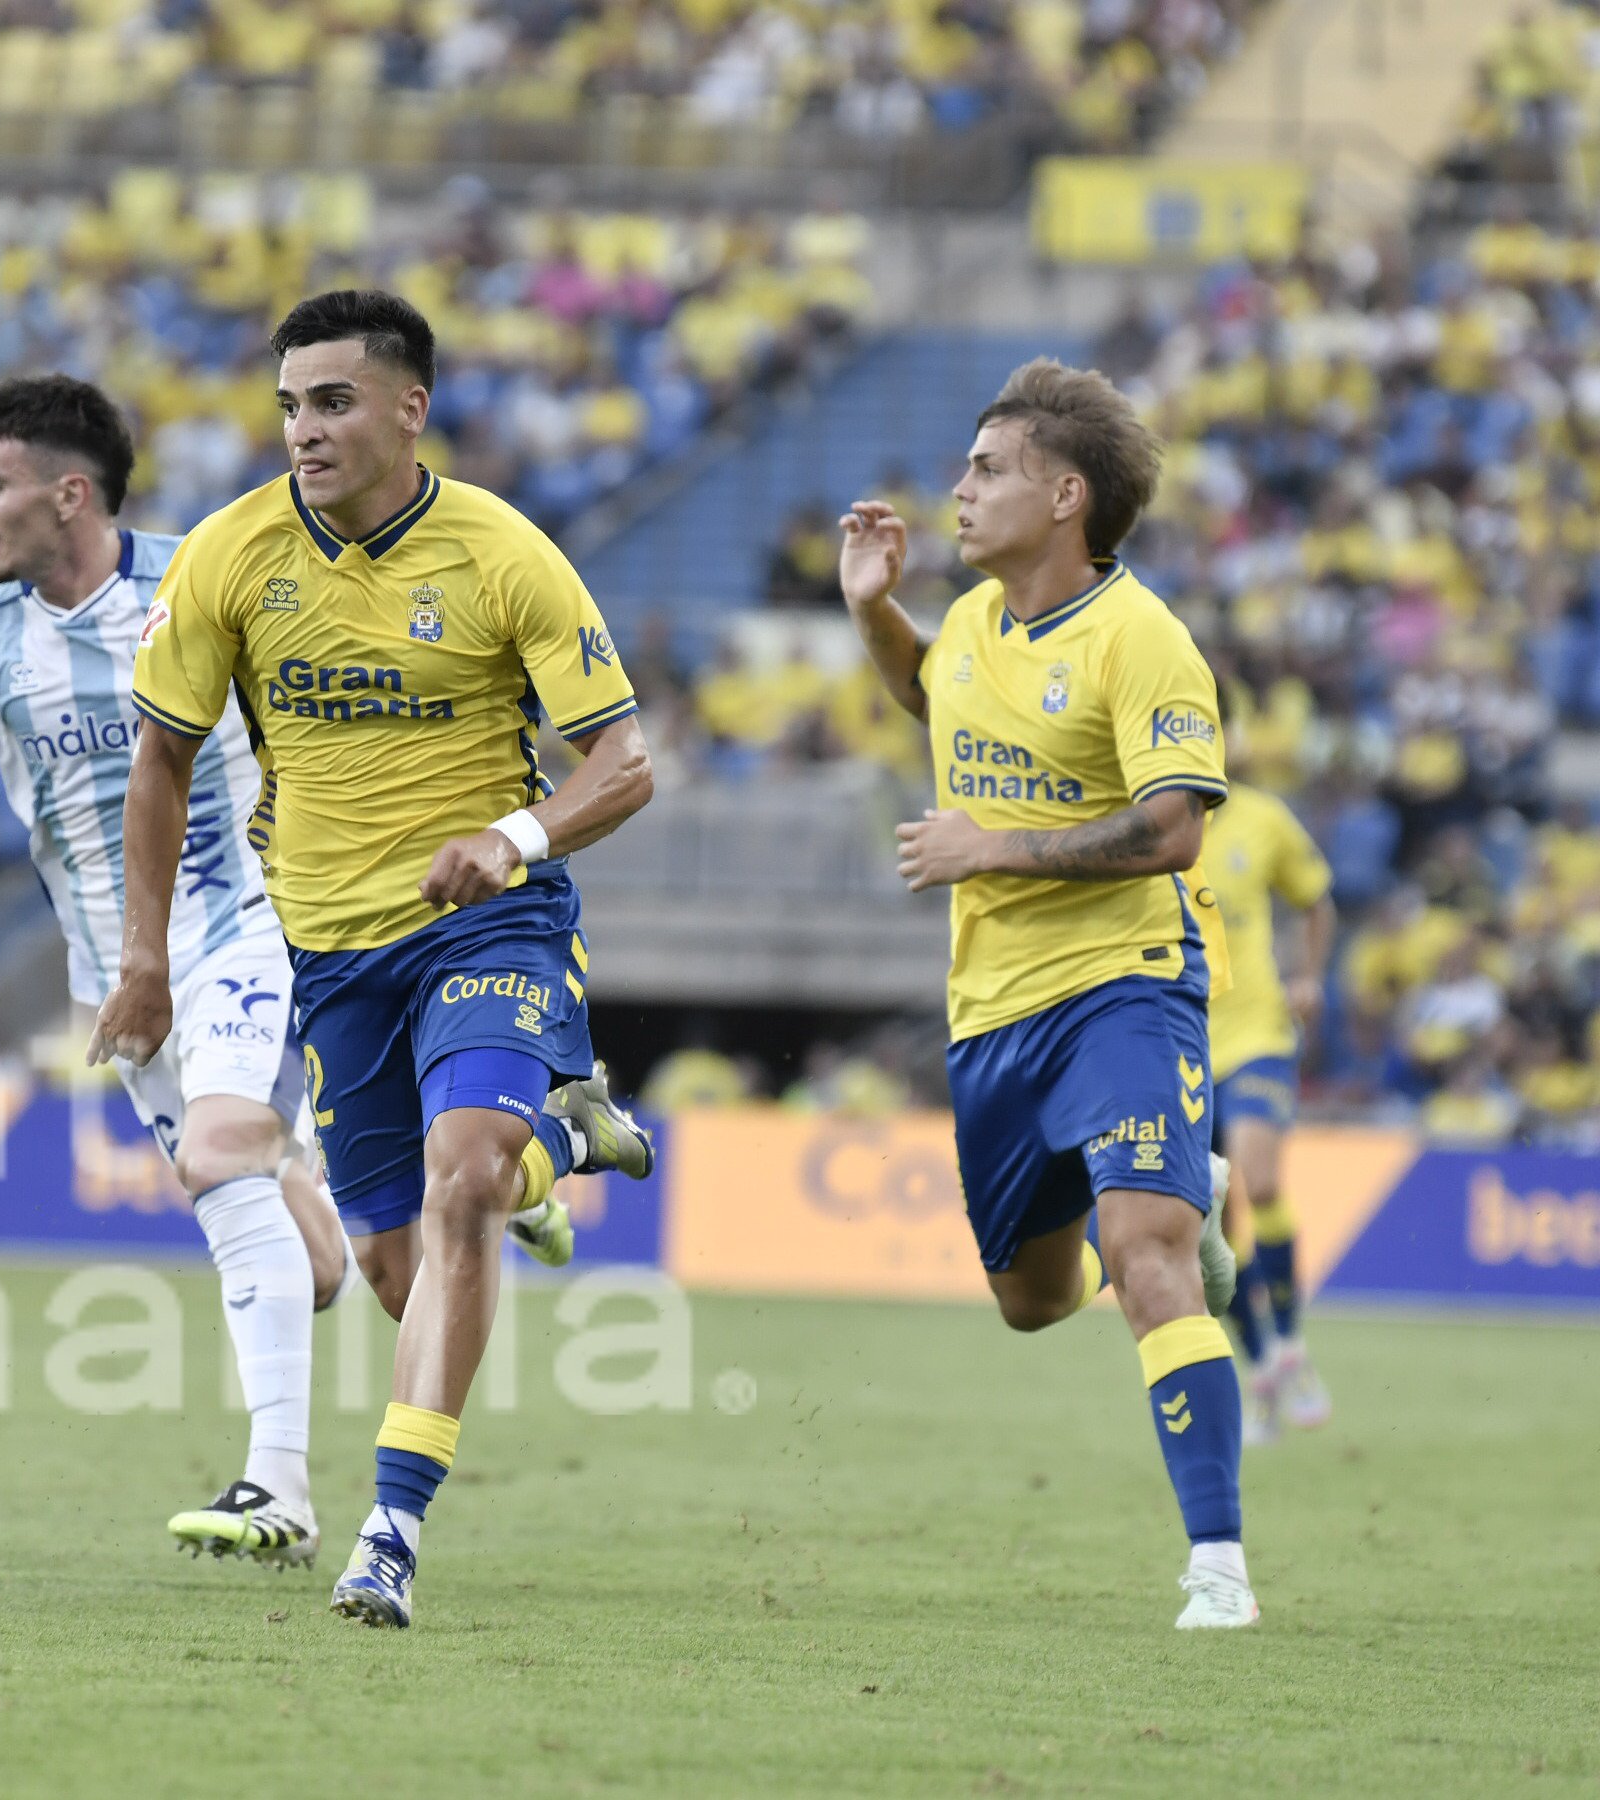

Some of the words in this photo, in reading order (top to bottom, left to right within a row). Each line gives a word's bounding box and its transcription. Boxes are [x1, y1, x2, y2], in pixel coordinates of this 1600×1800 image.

[264, 598, 298, 610] hummel
[279, 658, 402, 692] Gran
[268, 681, 455, 721] Canaria
[1152, 707, 1215, 749] Kalise
[954, 729, 1033, 768] Gran
[949, 763, 1084, 802] Canaria
[441, 972, 550, 1012] Cordial
[208, 1021, 275, 1045] MGS
